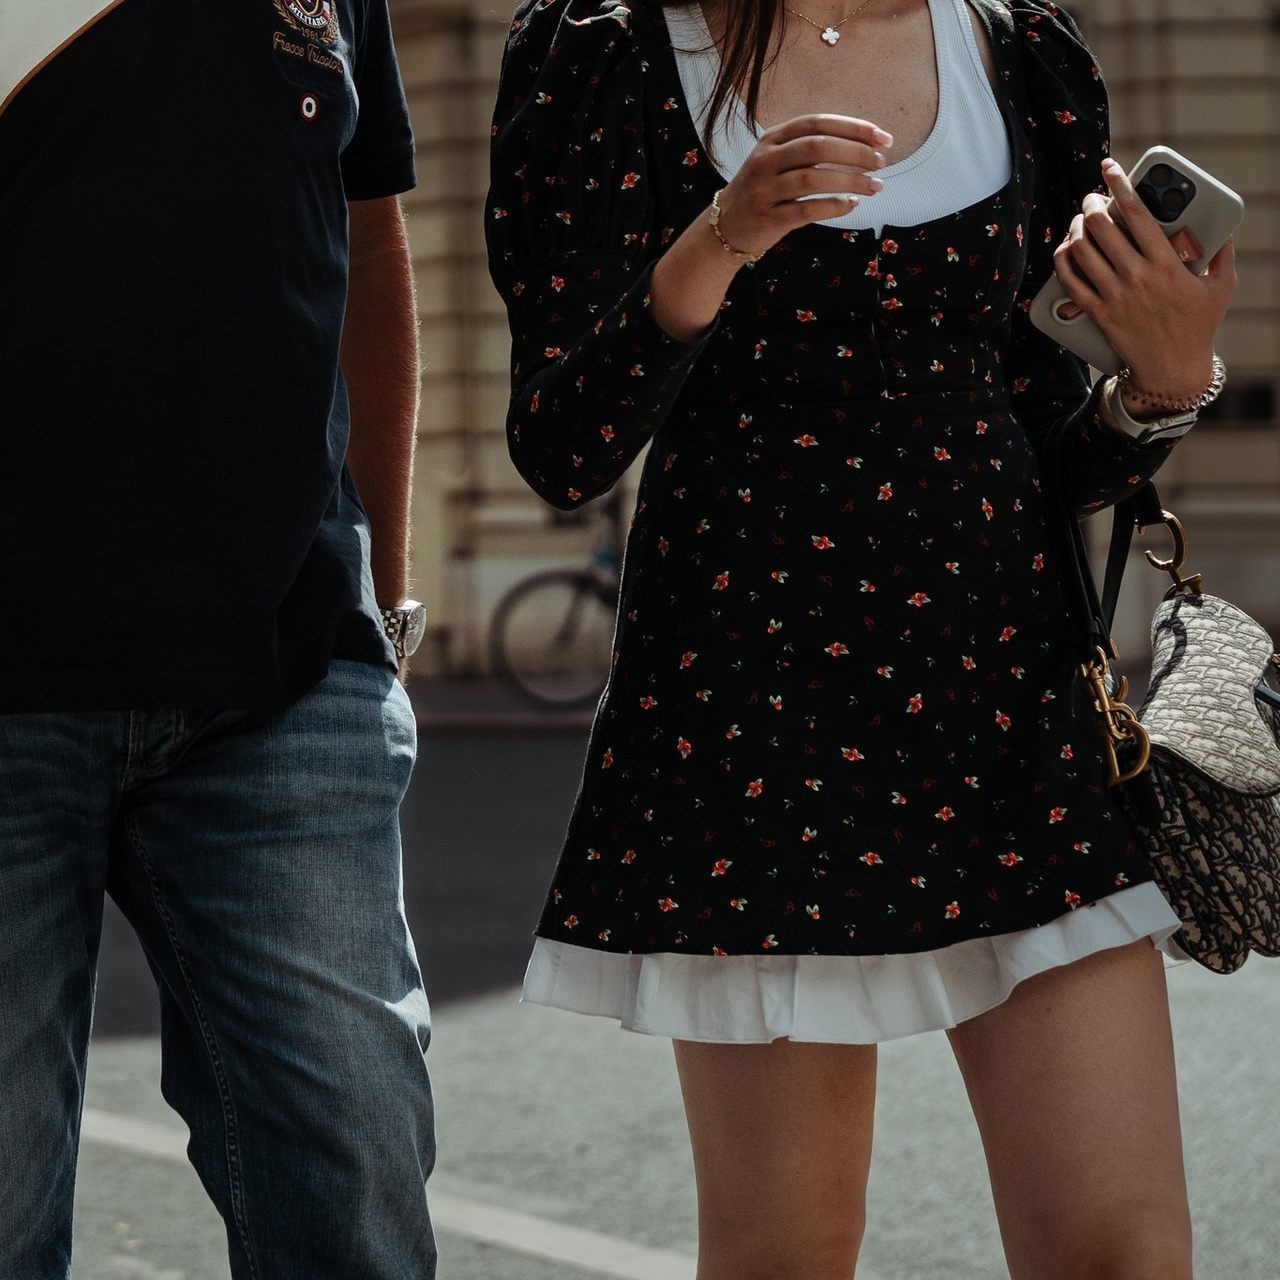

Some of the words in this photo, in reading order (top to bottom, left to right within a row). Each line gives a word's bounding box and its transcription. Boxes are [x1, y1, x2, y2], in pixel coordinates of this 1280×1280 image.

[288, 2, 327, 26] MILITARE
[273, 31, 305, 57] Frecce
[300, 27, 320, 41] 1961
